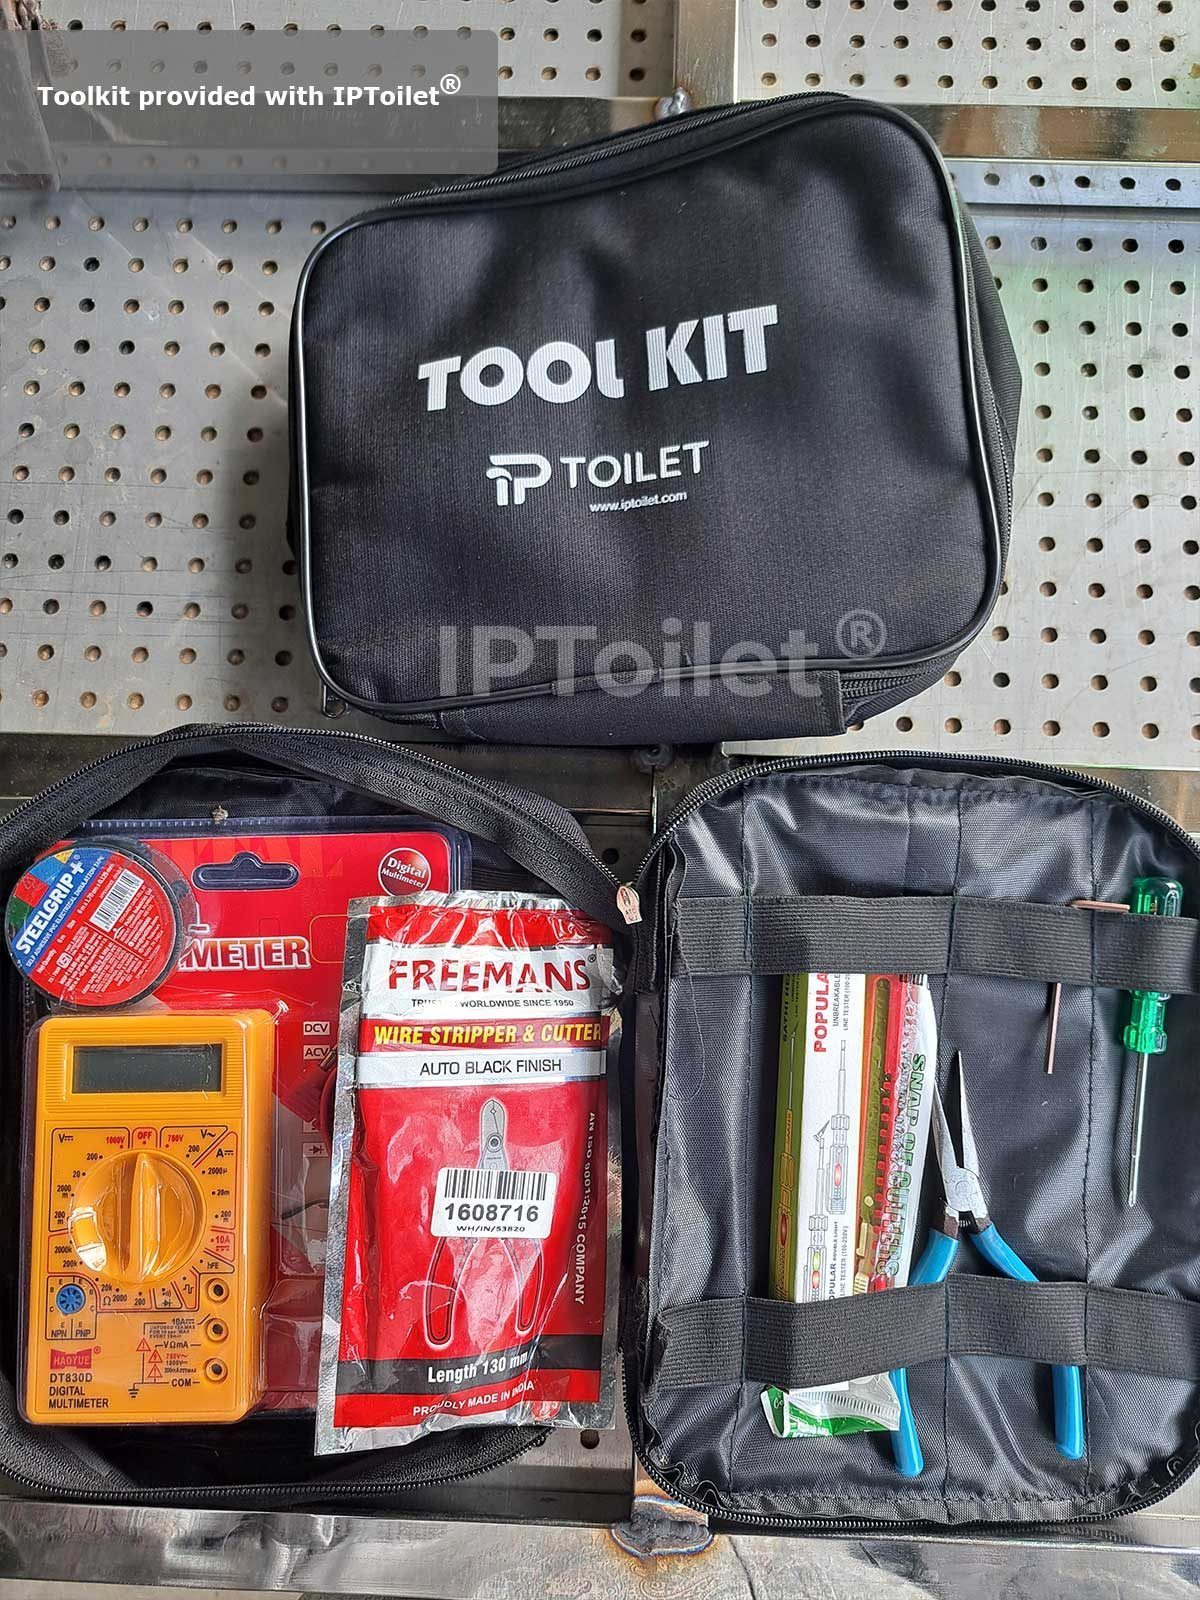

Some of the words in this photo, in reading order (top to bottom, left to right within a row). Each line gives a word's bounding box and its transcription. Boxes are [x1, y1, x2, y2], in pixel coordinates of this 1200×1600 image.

[418, 338, 625, 411] TOOL
[645, 304, 778, 391] KIT
[559, 440, 710, 489] TOILET
[589, 490, 688, 513] www.iptoilet.com
[387, 857, 427, 879] Digital
[381, 867, 425, 889] Multimeter
[460, 1000, 521, 1008] WORLDWIDE
[523, 999, 552, 1008] SINCE
[554, 999, 574, 1007] 1950
[832, 973, 842, 1027] UNBREAKABLE
[813, 973, 830, 1053] POPULA
[304, 1023, 328, 1033] DCV
[374, 1024, 423, 1046] WIRE
[429, 1024, 517, 1044] STRIPPER
[522, 1025, 535, 1042] &
[541, 1023, 602, 1043] CUTTER
[419, 1062, 460, 1076] AUTO
[465, 1060, 512, 1075] BLACK
[516, 1059, 562, 1073] FINISH
[907, 1053, 927, 1126] SNAP
[587, 1111, 597, 1132] AN
[137, 1131, 153, 1140] OFF
[86, 1153, 98, 1161] 200
[188, 1145, 199, 1153] 200
[902, 1131, 917, 1168] OF
[72, 1170, 81, 1178] 20
[54, 1211, 65, 1219] 200
[220, 1210, 232, 1218] 200
[444, 1202, 539, 1225] 1608716
[456, 1225, 526, 1233] WH/IN/53820
[215, 1235, 230, 1244] 10A
[574, 1233, 586, 1305] COMPANY
[828, 1263, 837, 1300] OPULAR
[50, 1329, 67, 1338] NPN
[75, 1329, 91, 1338] PNP
[427, 1363, 477, 1384] Length
[481, 1356, 506, 1375] 130
[509, 1351, 528, 1369] mm
[49, 1372, 93, 1383] DT830D
[171, 1378, 192, 1387] COM
[49, 1385, 86, 1396] DIGITAL
[412, 1399, 466, 1416] PROUDLY
[467, 1393, 499, 1407] MADE
[500, 1391, 511, 1401] IN
[511, 1380, 535, 1398] INDIA
[48, 1398, 109, 1409] MULTIMETER
